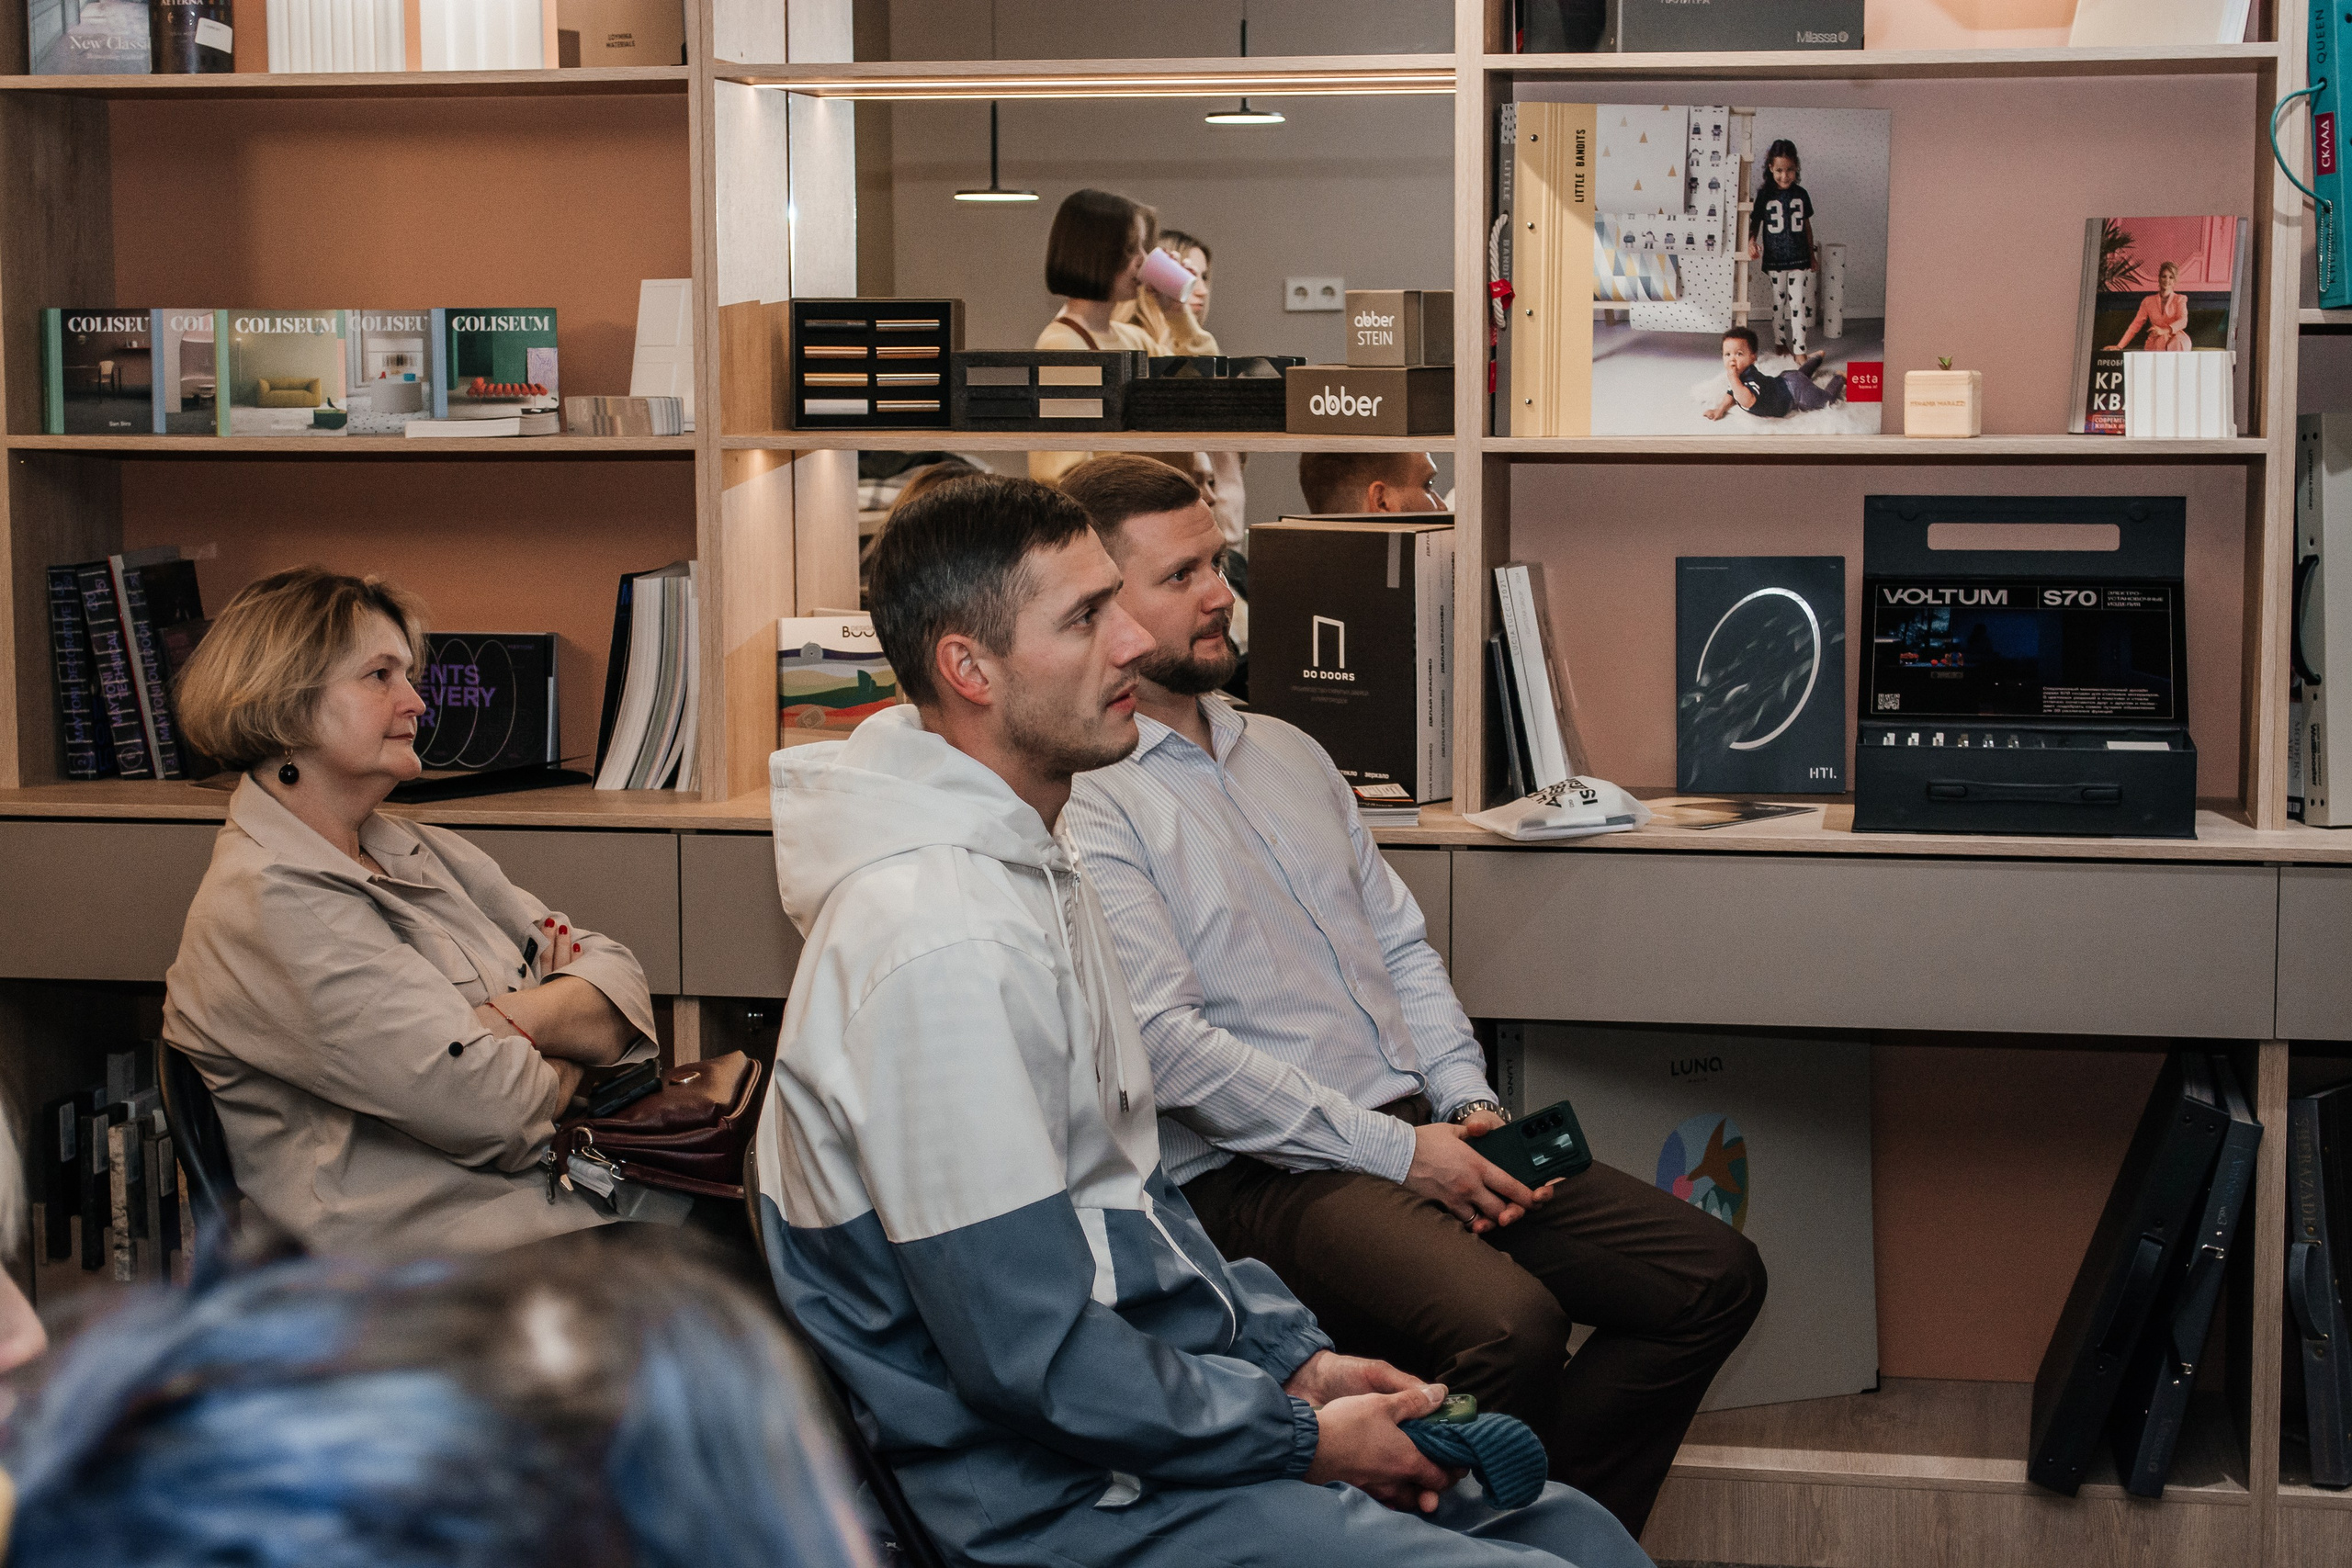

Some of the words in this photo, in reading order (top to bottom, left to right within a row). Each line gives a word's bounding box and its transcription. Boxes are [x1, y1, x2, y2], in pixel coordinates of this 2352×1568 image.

[69, 36, 102, 50] New
[1796, 30, 1838, 44] Milassa
[2315, 9, 2328, 64] QUEEN
[1576, 129, 1586, 167] BANDITS
[1503, 159, 1511, 201] LITTLE
[1575, 173, 1585, 203] LITTLE
[1766, 198, 1804, 234] 32
[234, 317, 337, 334] COLISEUM
[451, 315, 550, 332] COLISEUM
[1353, 310, 1396, 328] abber
[1357, 331, 1394, 346] STEIN
[1851, 374, 1879, 384] esta
[1309, 386, 1383, 418] abber
[1883, 588, 2008, 605] VOLTUM
[2043, 590, 2098, 606] S70
[1505, 601, 1515, 628] TUCCI
[1303, 670, 1317, 679] DO
[1319, 671, 1356, 682] DOORS
[1363, 772, 1390, 780] зеркало
